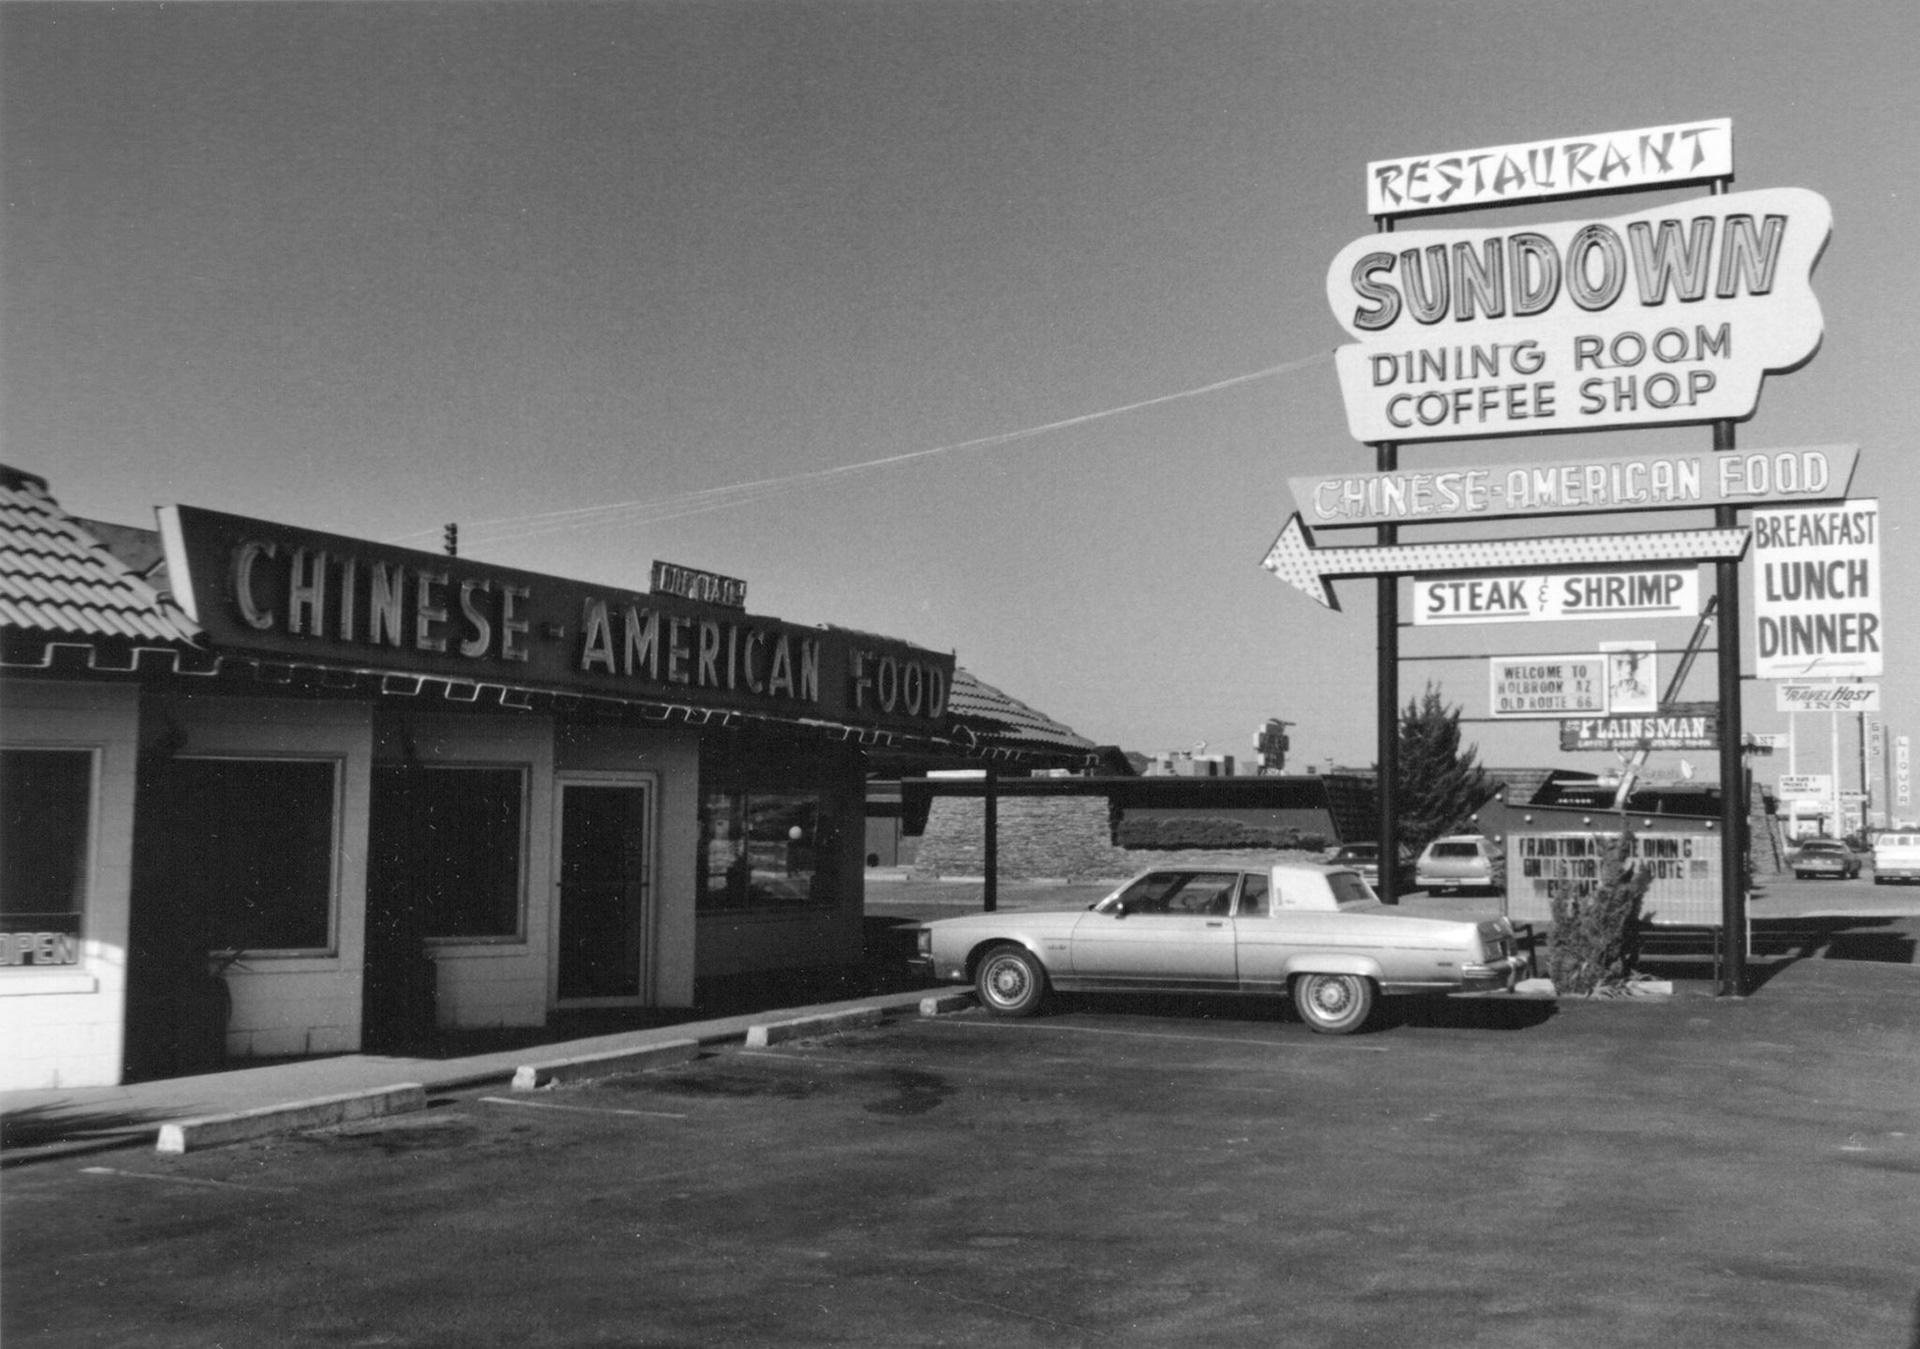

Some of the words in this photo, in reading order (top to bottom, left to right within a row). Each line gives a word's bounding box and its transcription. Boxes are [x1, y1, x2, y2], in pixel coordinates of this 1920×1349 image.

[1374, 125, 1723, 207] RESTAURANT
[1350, 213, 1788, 331] SUNDOWN
[1371, 340, 1546, 387] DINING
[1574, 323, 1732, 371] ROOM
[1385, 381, 1556, 428] COFFEE
[1579, 370, 1717, 416] SHOP
[1718, 451, 1829, 498] FOOD
[1755, 511, 1877, 549] BREAKFAST
[1427, 579, 1529, 613] STEAK
[1537, 576, 1549, 612] &
[1562, 573, 1684, 608] SHRIMP
[1765, 559, 1869, 601] LUNCH
[1758, 612, 1880, 658] DINNER
[848, 644, 945, 719] FOOD
[1498, 680, 1564, 694] HOLBROOK
[1575, 680, 1592, 693] AZ
[1503, 665, 1563, 679] WELCOME
[1571, 665, 1588, 678] TO
[1500, 697, 1525, 709] OLD
[1529, 696, 1567, 709] ROUTE
[1577, 696, 1593, 708] 66
[1803, 701, 1851, 709] INN
[1579, 717, 1706, 739] PLAINSMAN
[1643, 838, 1693, 858] DINING
